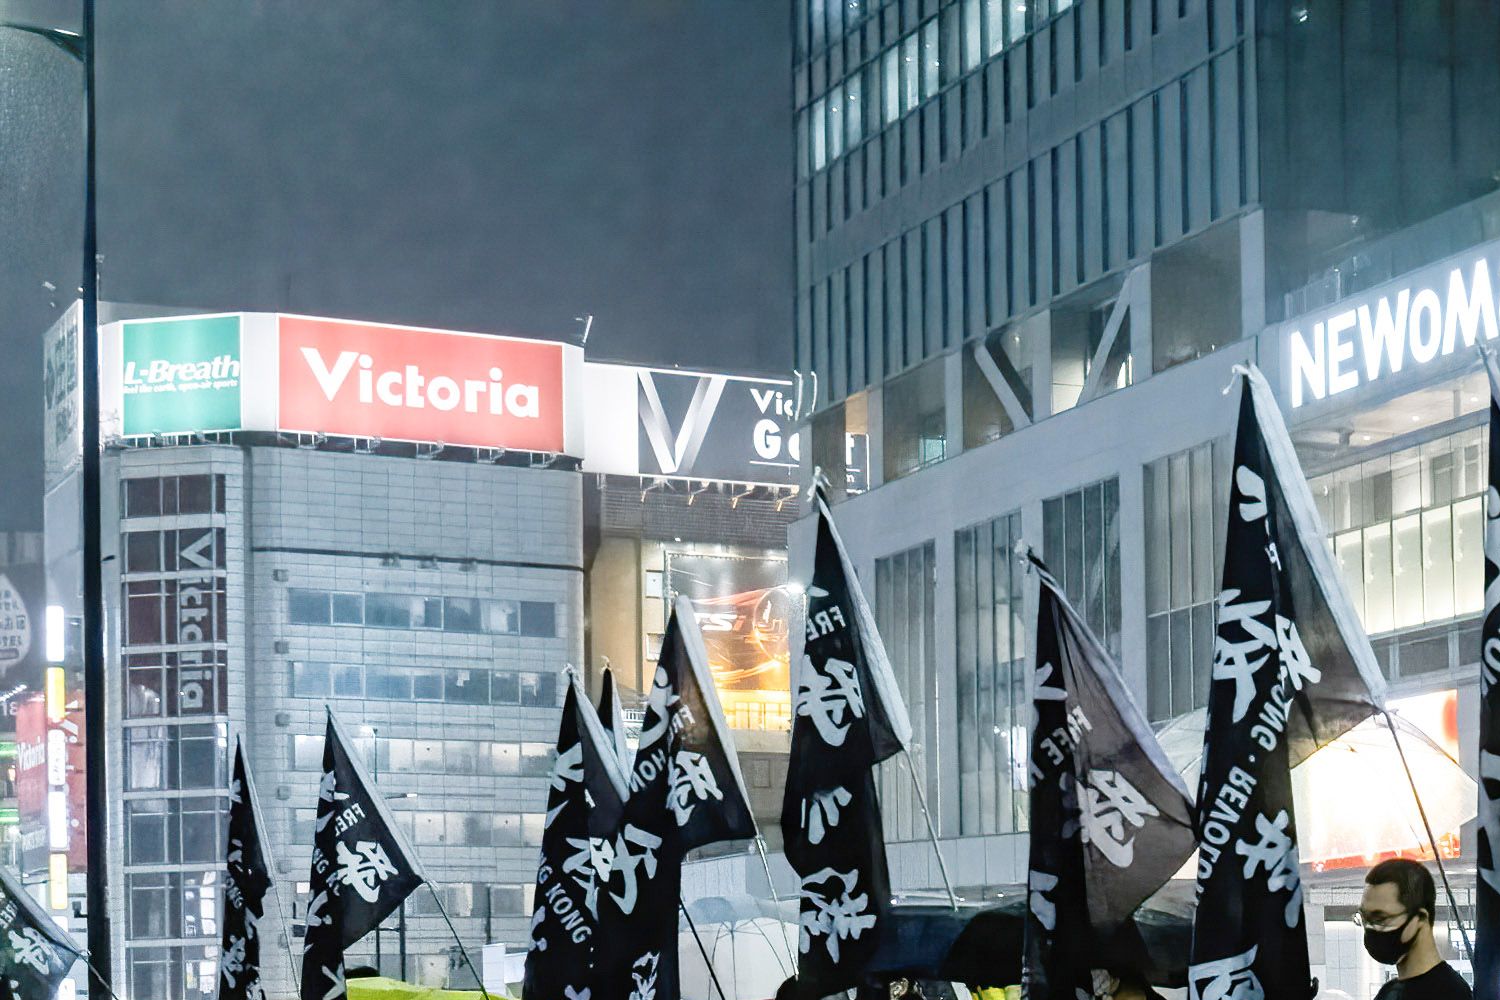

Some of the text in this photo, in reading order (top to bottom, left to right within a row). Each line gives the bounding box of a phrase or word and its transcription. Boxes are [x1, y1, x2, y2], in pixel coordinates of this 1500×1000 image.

[124, 355, 240, 384] L-Breath
[300, 347, 539, 418] Victoria
[179, 531, 213, 709] Victoria
